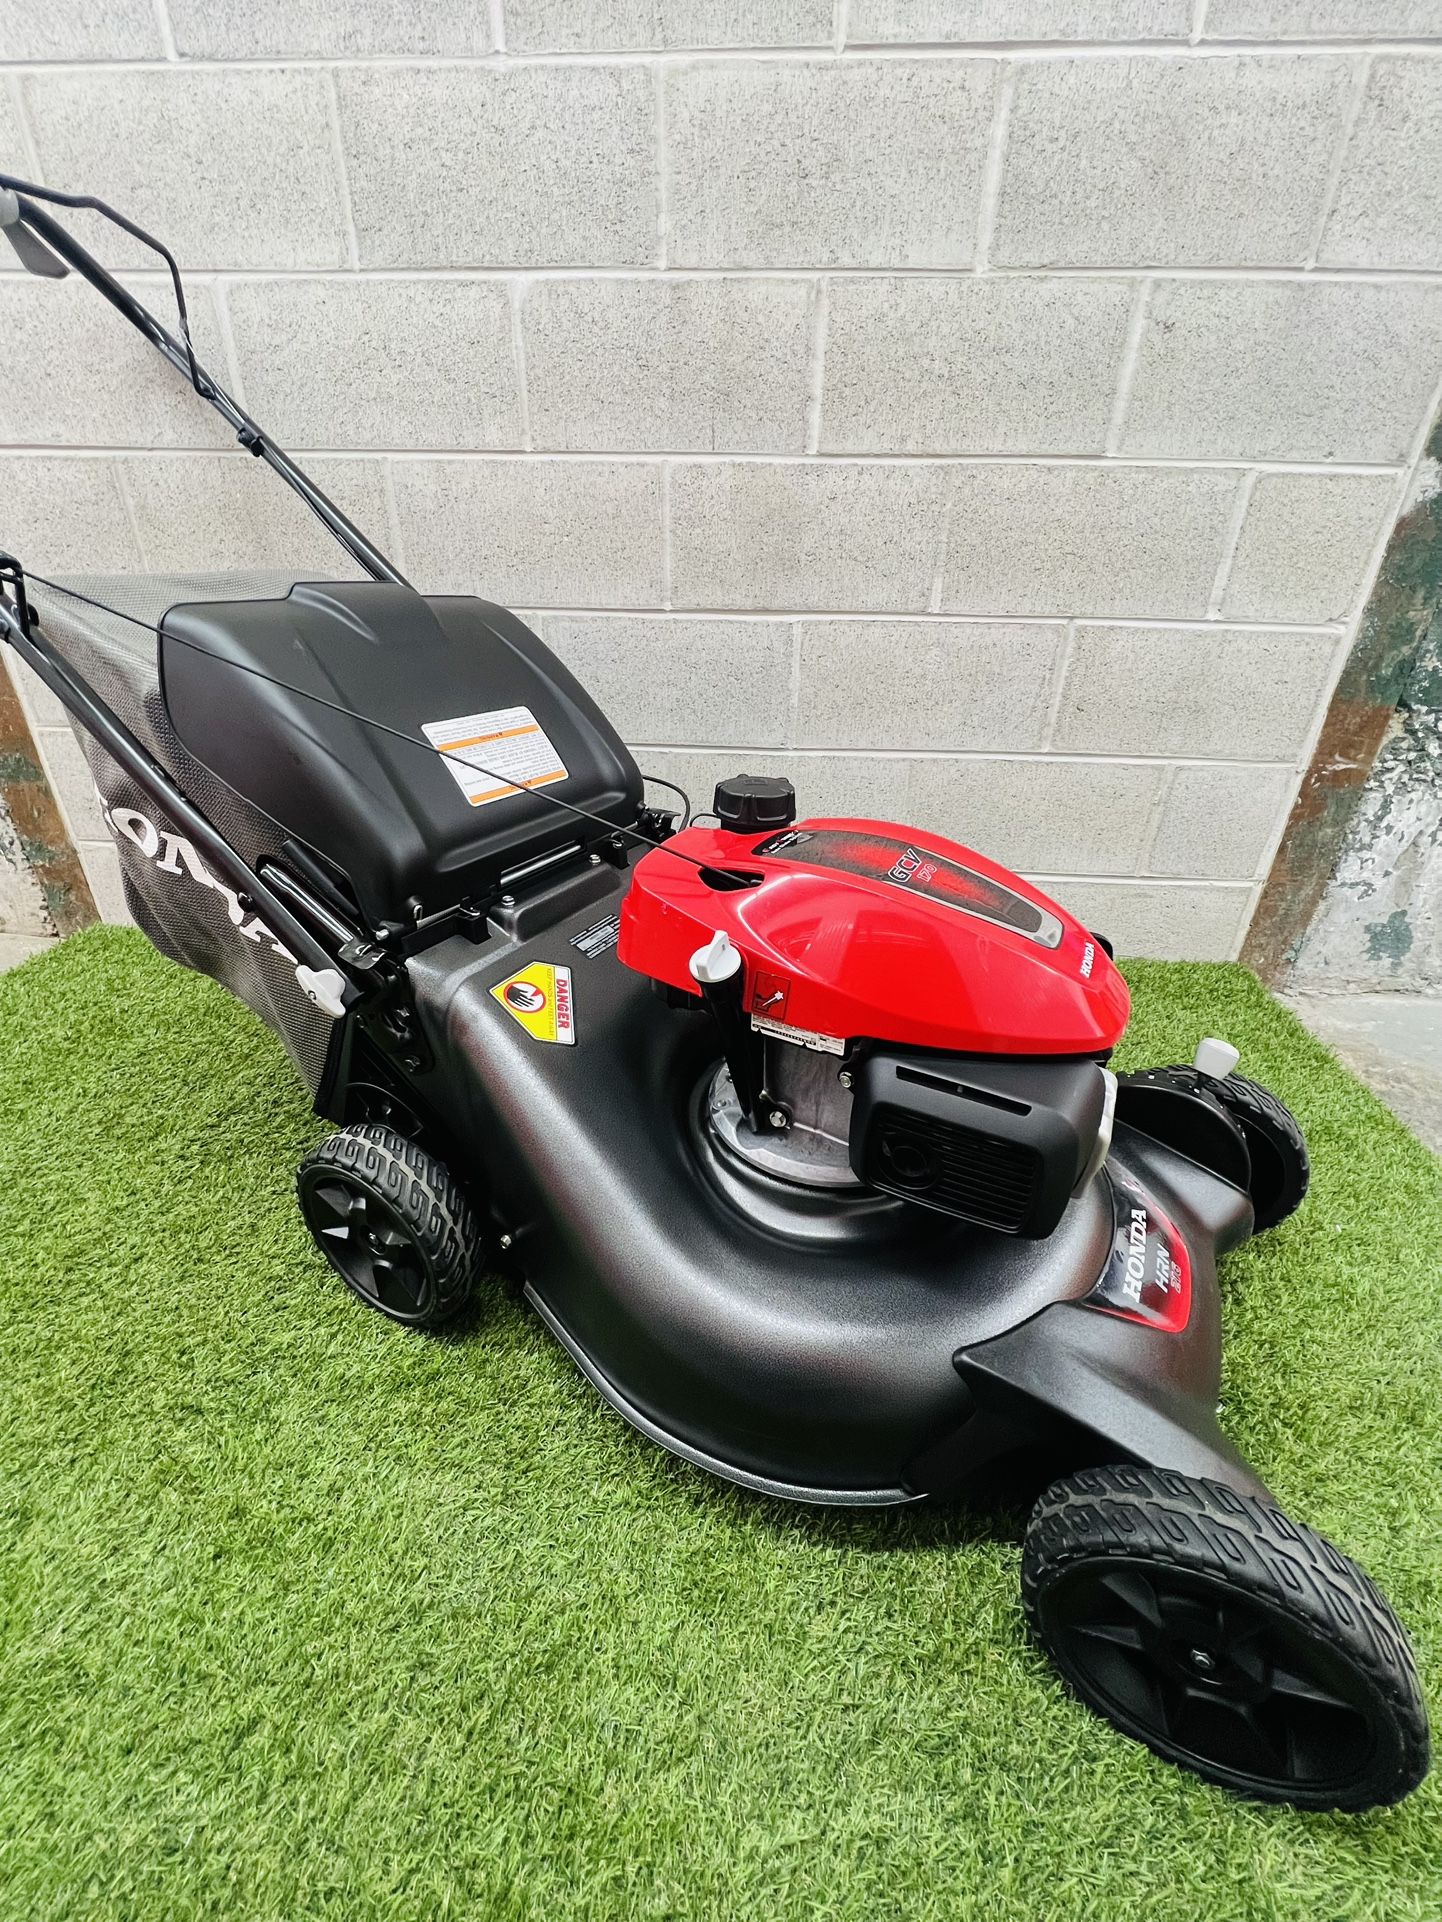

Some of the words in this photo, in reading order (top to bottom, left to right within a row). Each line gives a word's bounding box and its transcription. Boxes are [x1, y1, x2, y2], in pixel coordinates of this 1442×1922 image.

[888, 848, 922, 883] GCV
[916, 864, 937, 882] 170
[1080, 942, 1095, 979] HONDA
[556, 978, 571, 1029] DANGER
[1122, 1209, 1147, 1303] HONDA
[1155, 1243, 1170, 1293] HRN
